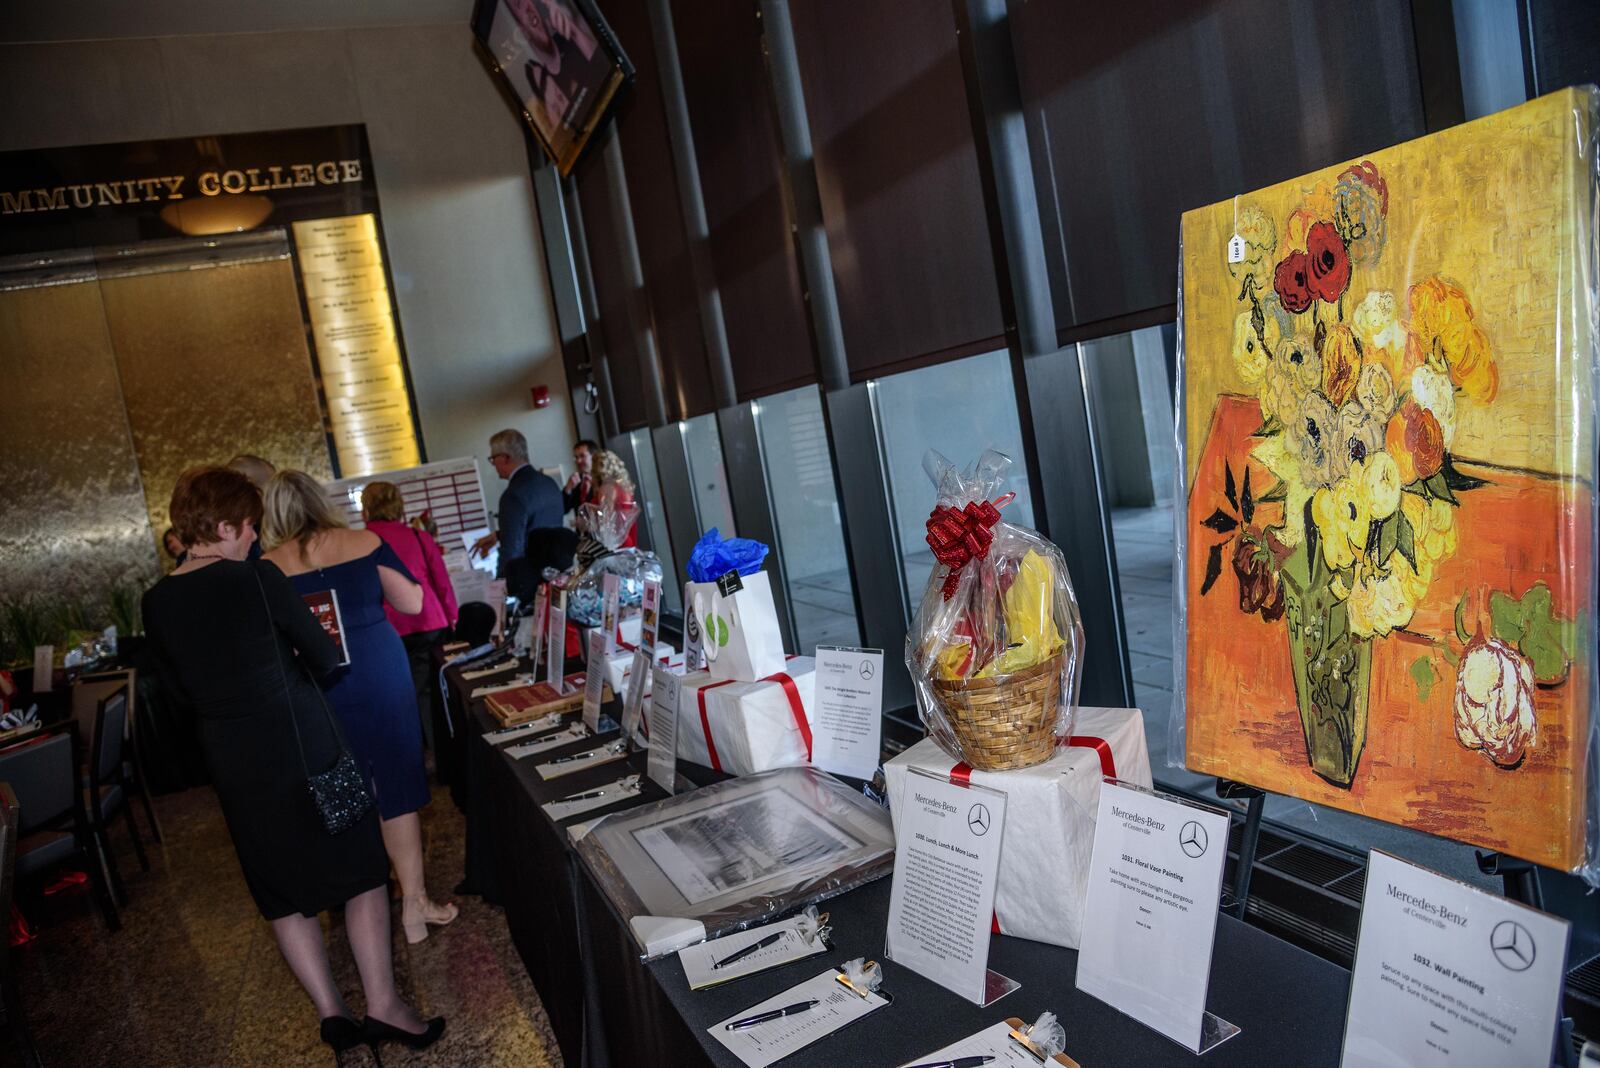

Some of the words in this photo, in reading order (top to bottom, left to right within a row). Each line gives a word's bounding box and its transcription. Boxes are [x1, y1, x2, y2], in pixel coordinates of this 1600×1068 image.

[200, 159, 363, 197] COLLEGE
[915, 793, 957, 813] Mercedes-Benz
[1111, 806, 1165, 831] Mercedes-Benz
[925, 836, 938, 847] Lunch,
[938, 840, 950, 850] Lunch
[955, 847, 966, 856] More
[966, 851, 979, 860] Lunch
[1121, 853, 1134, 864] 1031.
[1135, 858, 1149, 869] Floral
[1149, 864, 1162, 874] Vase
[1162, 868, 1184, 883] Painting
[1172, 892, 1194, 905] gorgeous
[1386, 883, 1469, 928] Mercedes-Benz
[1402, 906, 1411, 915] of
[1410, 909, 1447, 930] Centerville
[1381, 961, 1401, 976] Spruce
[1401, 970, 1410, 981] up
[1410, 974, 1423, 987] any
[1422, 981, 1440, 995] space
[1440, 988, 1456, 1003] with
[1456, 995, 1470, 1010] this
[1413, 953, 1432, 969] 1032.
[1433, 962, 1451, 978] Wall
[1451, 971, 1485, 995] Painting
[1405, 982, 1421, 997] Sure
[1420, 990, 1429, 1002] to
[1429, 995, 1447, 1012] make
[1446, 1004, 1461, 1019] any
[1459, 1010, 1480, 1028] space
[1479, 1018, 1497, 1037] look
